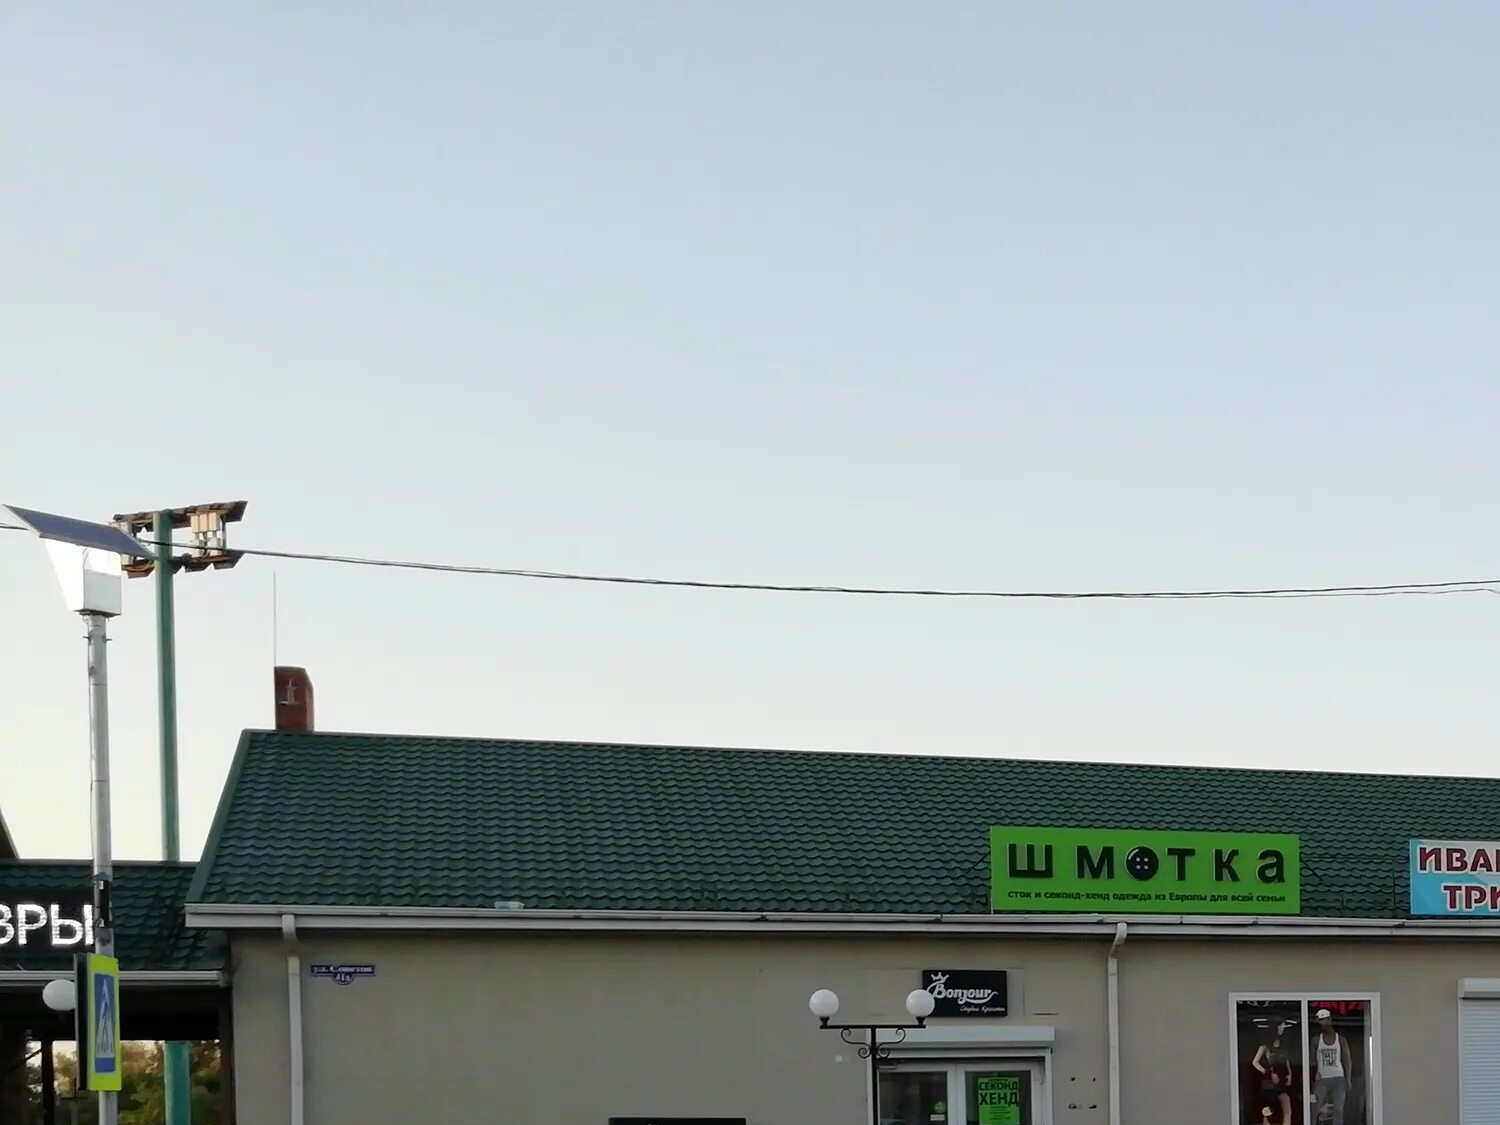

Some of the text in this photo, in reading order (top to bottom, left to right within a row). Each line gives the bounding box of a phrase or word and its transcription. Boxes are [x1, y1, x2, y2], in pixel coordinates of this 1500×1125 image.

[1169, 892, 1207, 903] Европы
[926, 980, 999, 1005] Bonjour
[980, 1092, 1019, 1107] ХЕНД
